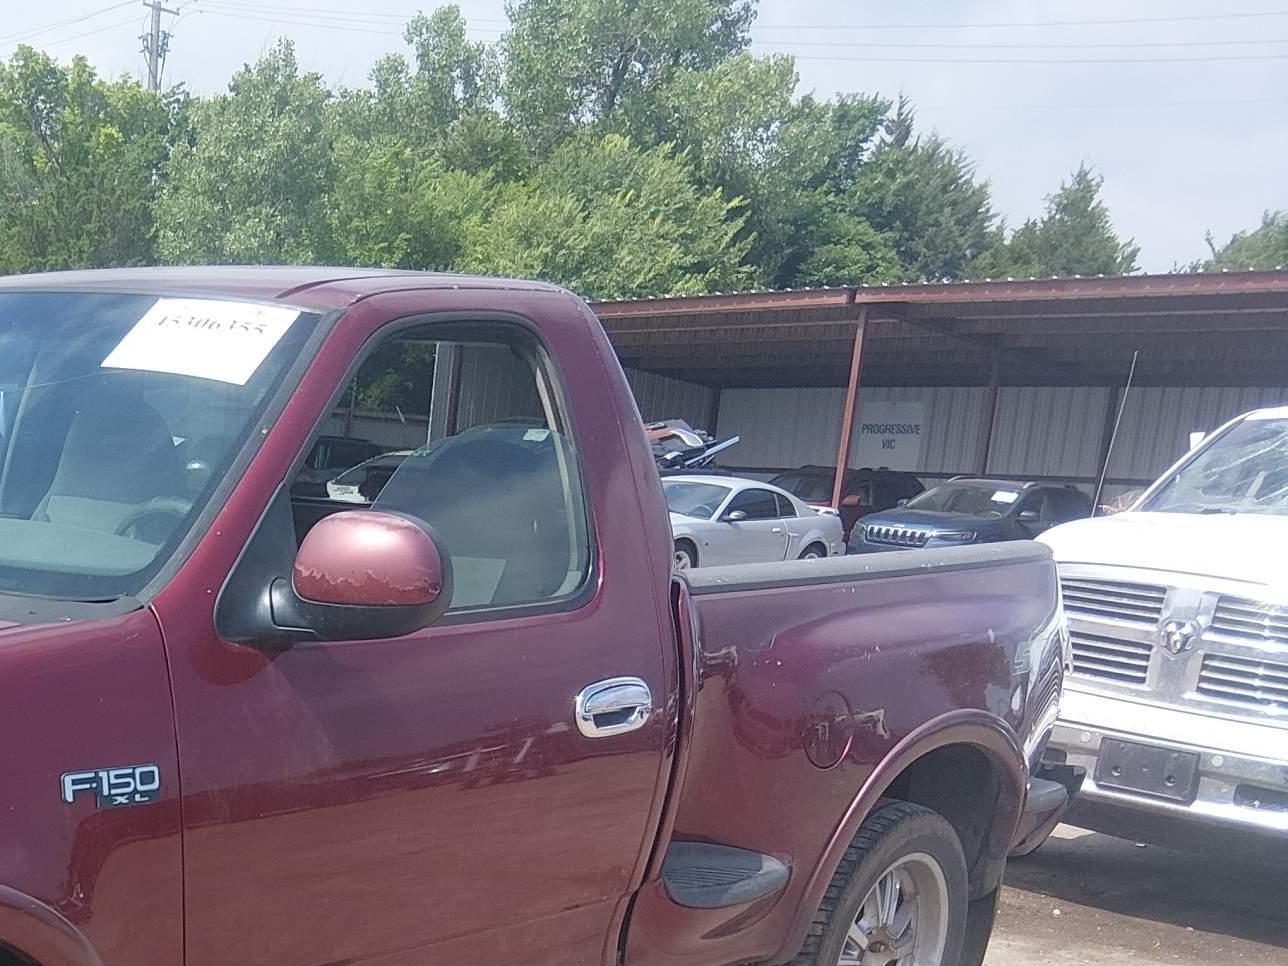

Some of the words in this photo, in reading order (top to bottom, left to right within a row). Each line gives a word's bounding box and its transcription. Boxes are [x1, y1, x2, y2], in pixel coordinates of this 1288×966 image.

[861, 423, 921, 435] PROGRESSIVE
[881, 438, 896, 450] VIC
[111, 793, 150, 805] XL
